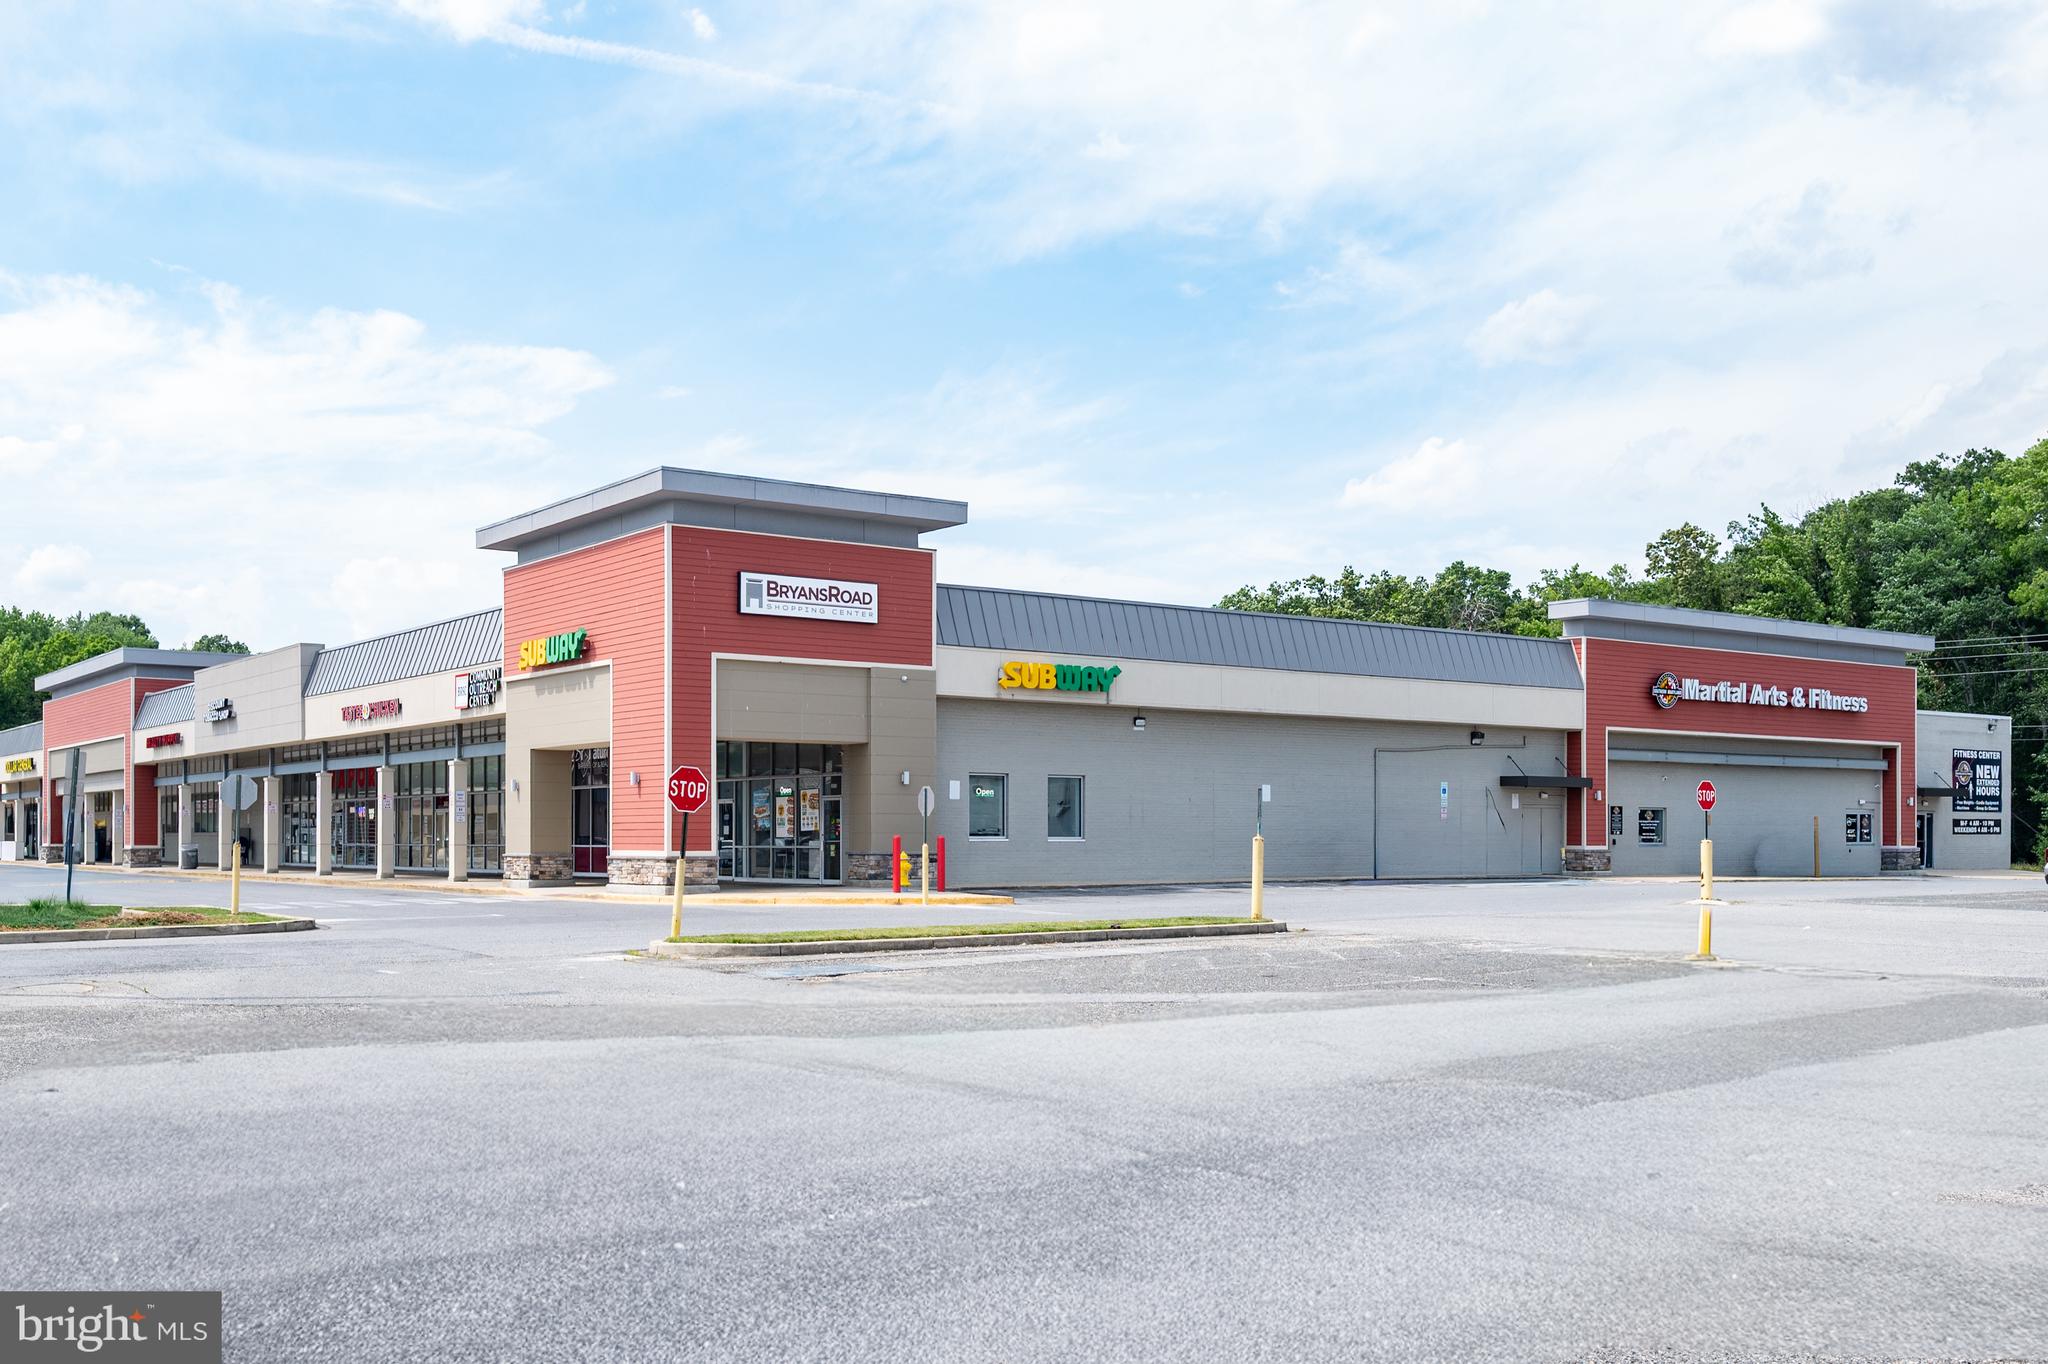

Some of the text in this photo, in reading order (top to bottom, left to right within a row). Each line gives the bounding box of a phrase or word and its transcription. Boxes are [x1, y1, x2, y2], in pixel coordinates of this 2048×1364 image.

[766, 603, 874, 618] SHOPPING CENTER
[518, 627, 587, 670] SUBWAY
[470, 668, 500, 683] COMMUNITY
[998, 661, 1121, 692] SUBWAY
[469, 680, 498, 695] OUTREACH
[1682, 678, 1747, 704] Martial
[1749, 684, 1788, 707] Arts
[1791, 687, 1806, 708] &
[1809, 688, 1868, 712] Fitness
[469, 694, 490, 707] CENTER
[1953, 750, 2000, 760] FITNESS CENTER
[1976, 764, 2000, 779] NEW
[670, 779, 706, 799] STOP
[975, 787, 995, 797] Open
[1698, 789, 1715, 802] STOP
[1976, 786, 2000, 797] HOURS
